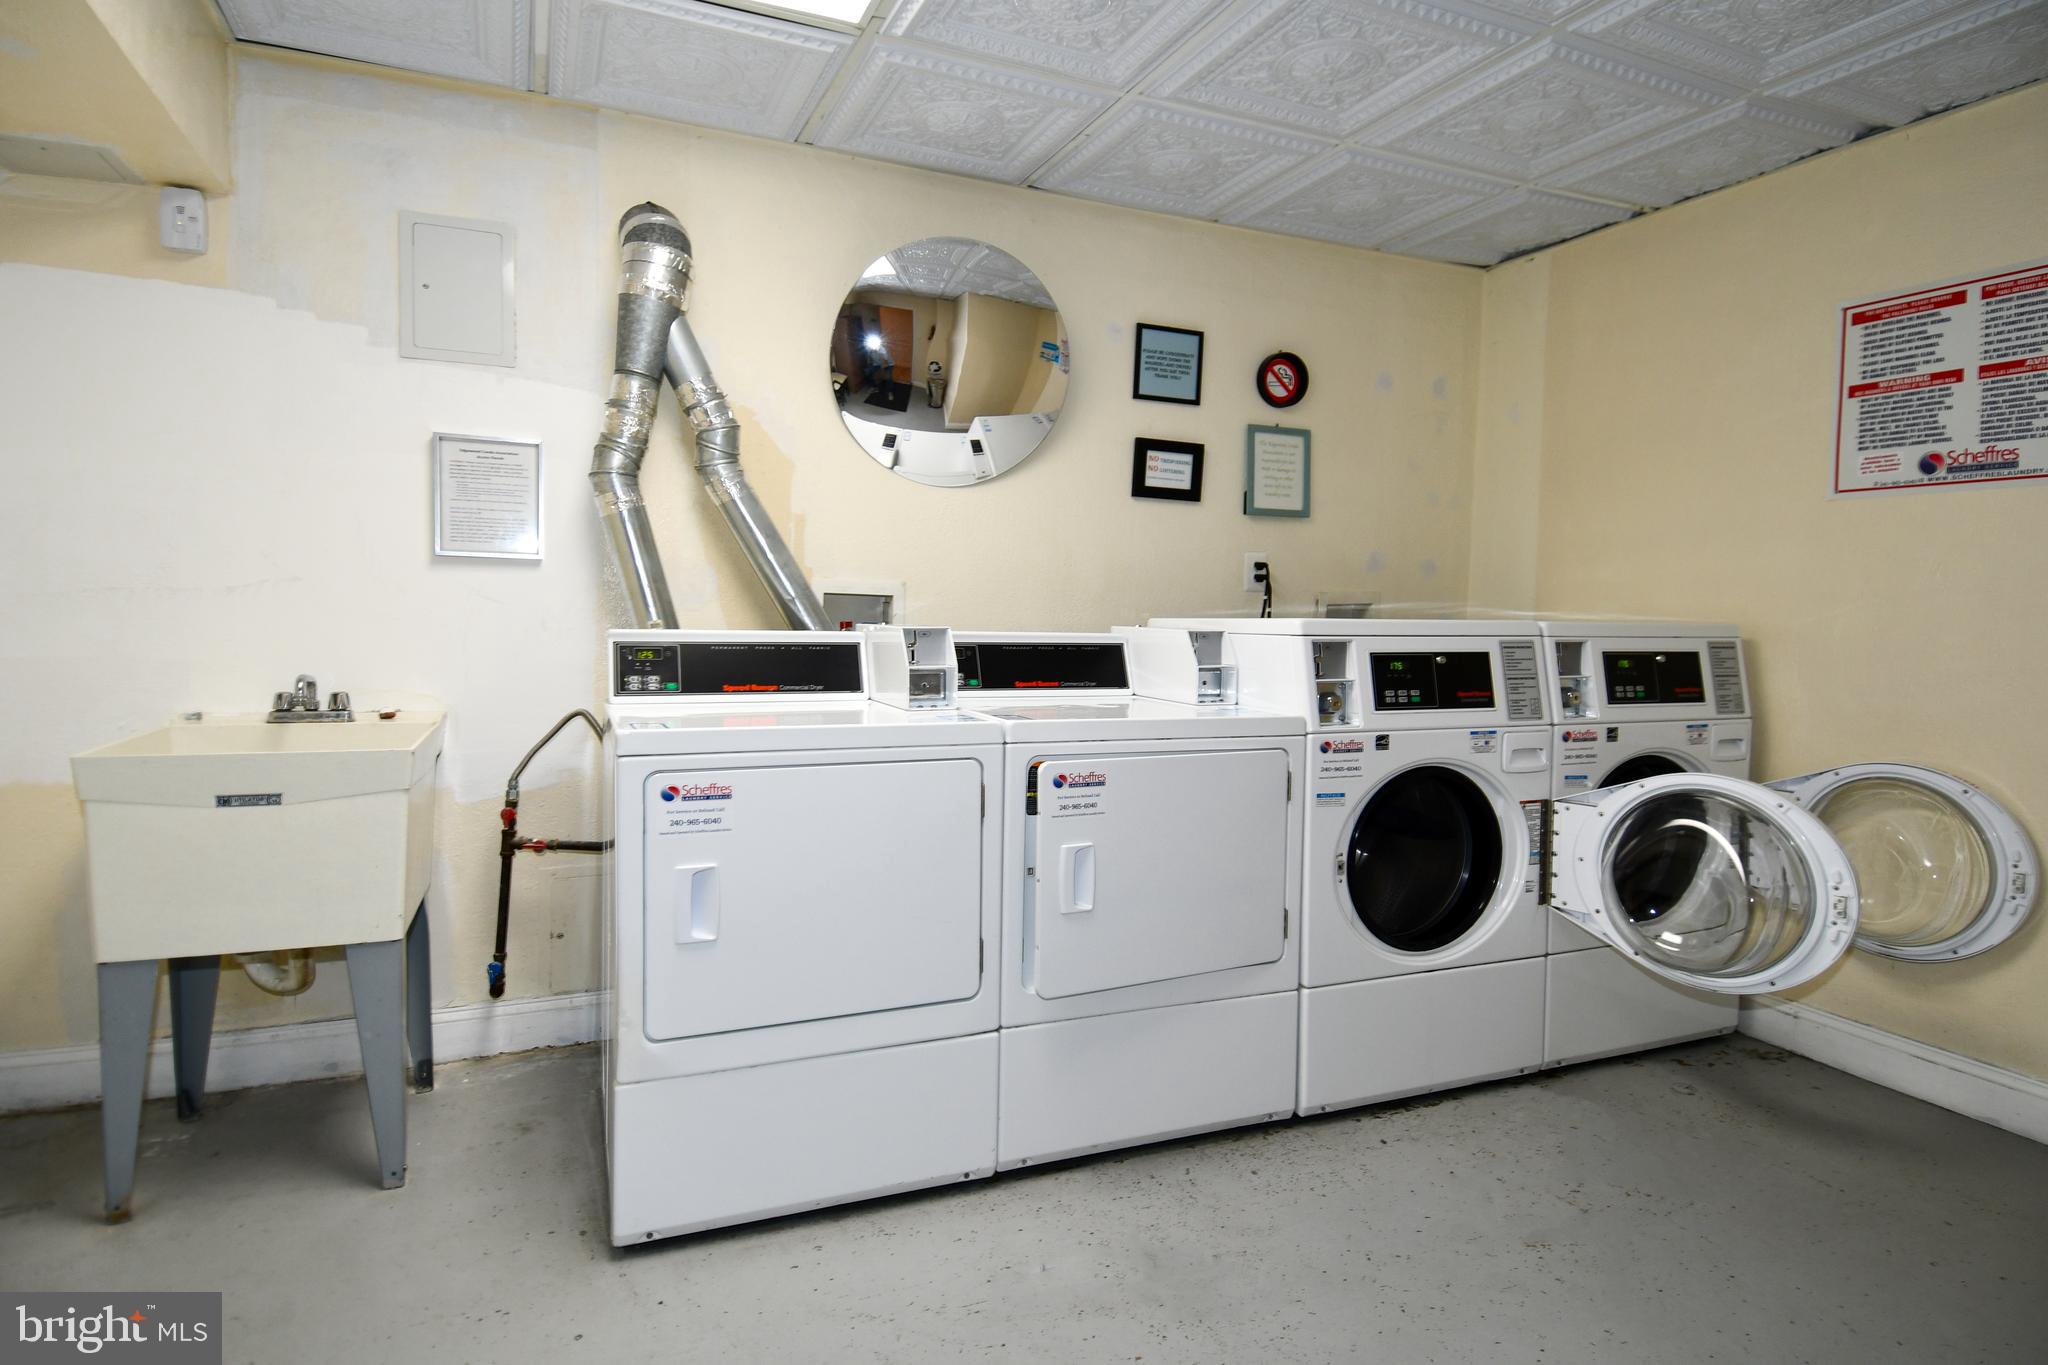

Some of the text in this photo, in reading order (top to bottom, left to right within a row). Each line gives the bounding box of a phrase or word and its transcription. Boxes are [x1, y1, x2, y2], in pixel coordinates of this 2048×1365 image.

[1946, 445, 2020, 466] Scheffres
[1333, 740, 1364, 750] Scheffres
[1068, 771, 1107, 784] Scheffres
[682, 783, 733, 796] Scheffres
[1059, 802, 1098, 811] 240-965-6040
[669, 817, 722, 827] 240-965-6040
